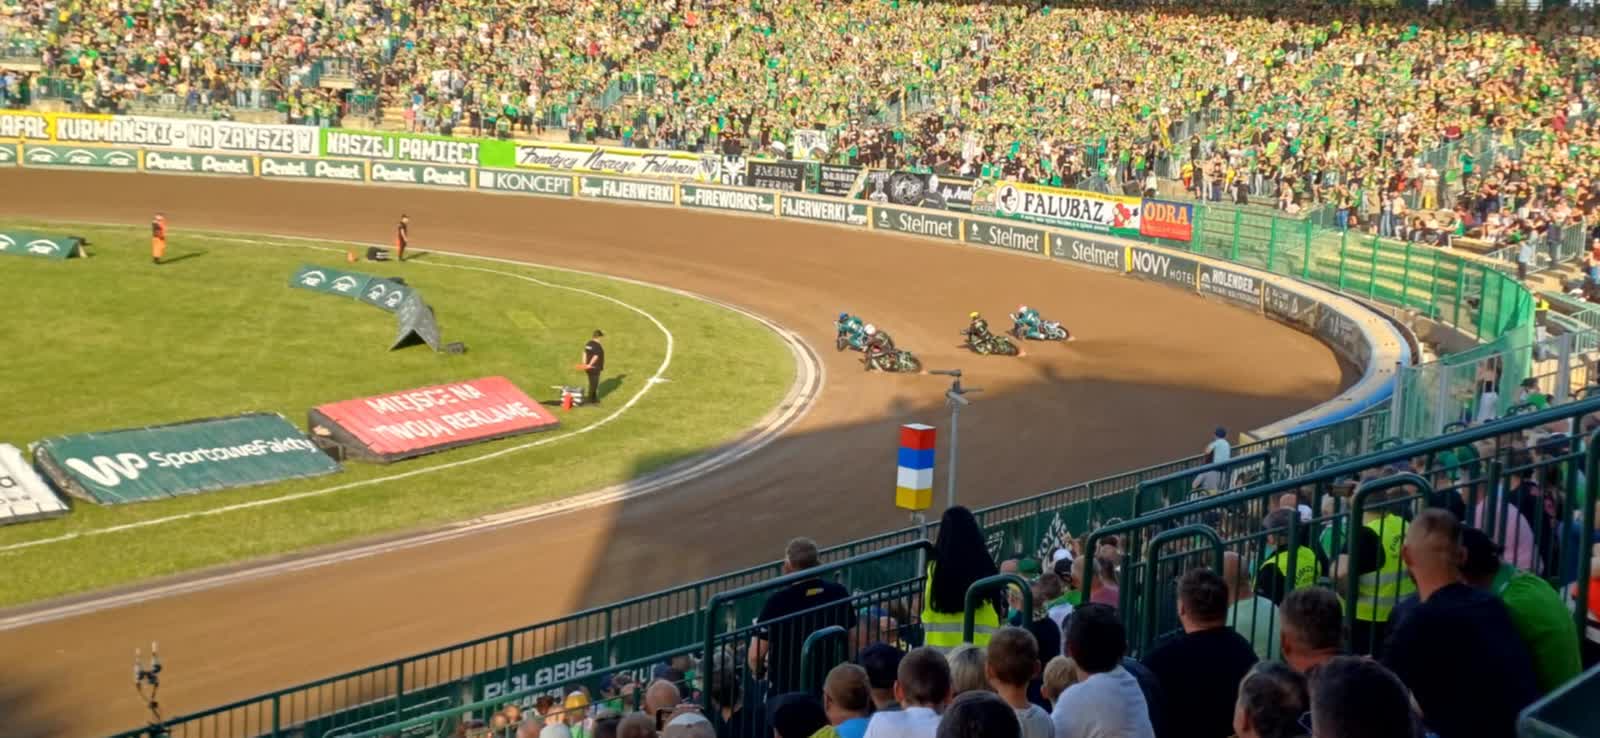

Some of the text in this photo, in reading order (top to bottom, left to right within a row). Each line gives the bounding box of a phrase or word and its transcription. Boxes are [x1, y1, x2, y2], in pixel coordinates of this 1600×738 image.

[187, 123, 214, 148] NA
[219, 126, 293, 152] ZAWSZE
[297, 129, 313, 153] W
[327, 132, 394, 158] NASZEJ
[497, 172, 571, 194] KONCEPT
[602, 179, 674, 201] FAJERWERKI
[695, 189, 757, 210] FIREWORKS
[780, 197, 846, 222] FAJERWERKI
[1023, 192, 1104, 222] FALUBAZ
[900, 212, 953, 238] Stelmet
[1143, 202, 1189, 225] ODRA
[989, 225, 1038, 252] Stelmet
[1072, 240, 1119, 269] Stelmet
[1131, 250, 1196, 287] NOVY HOTEL
[447, 384, 487, 401] NA
[65, 437, 317, 486] WP SportoweFakty
